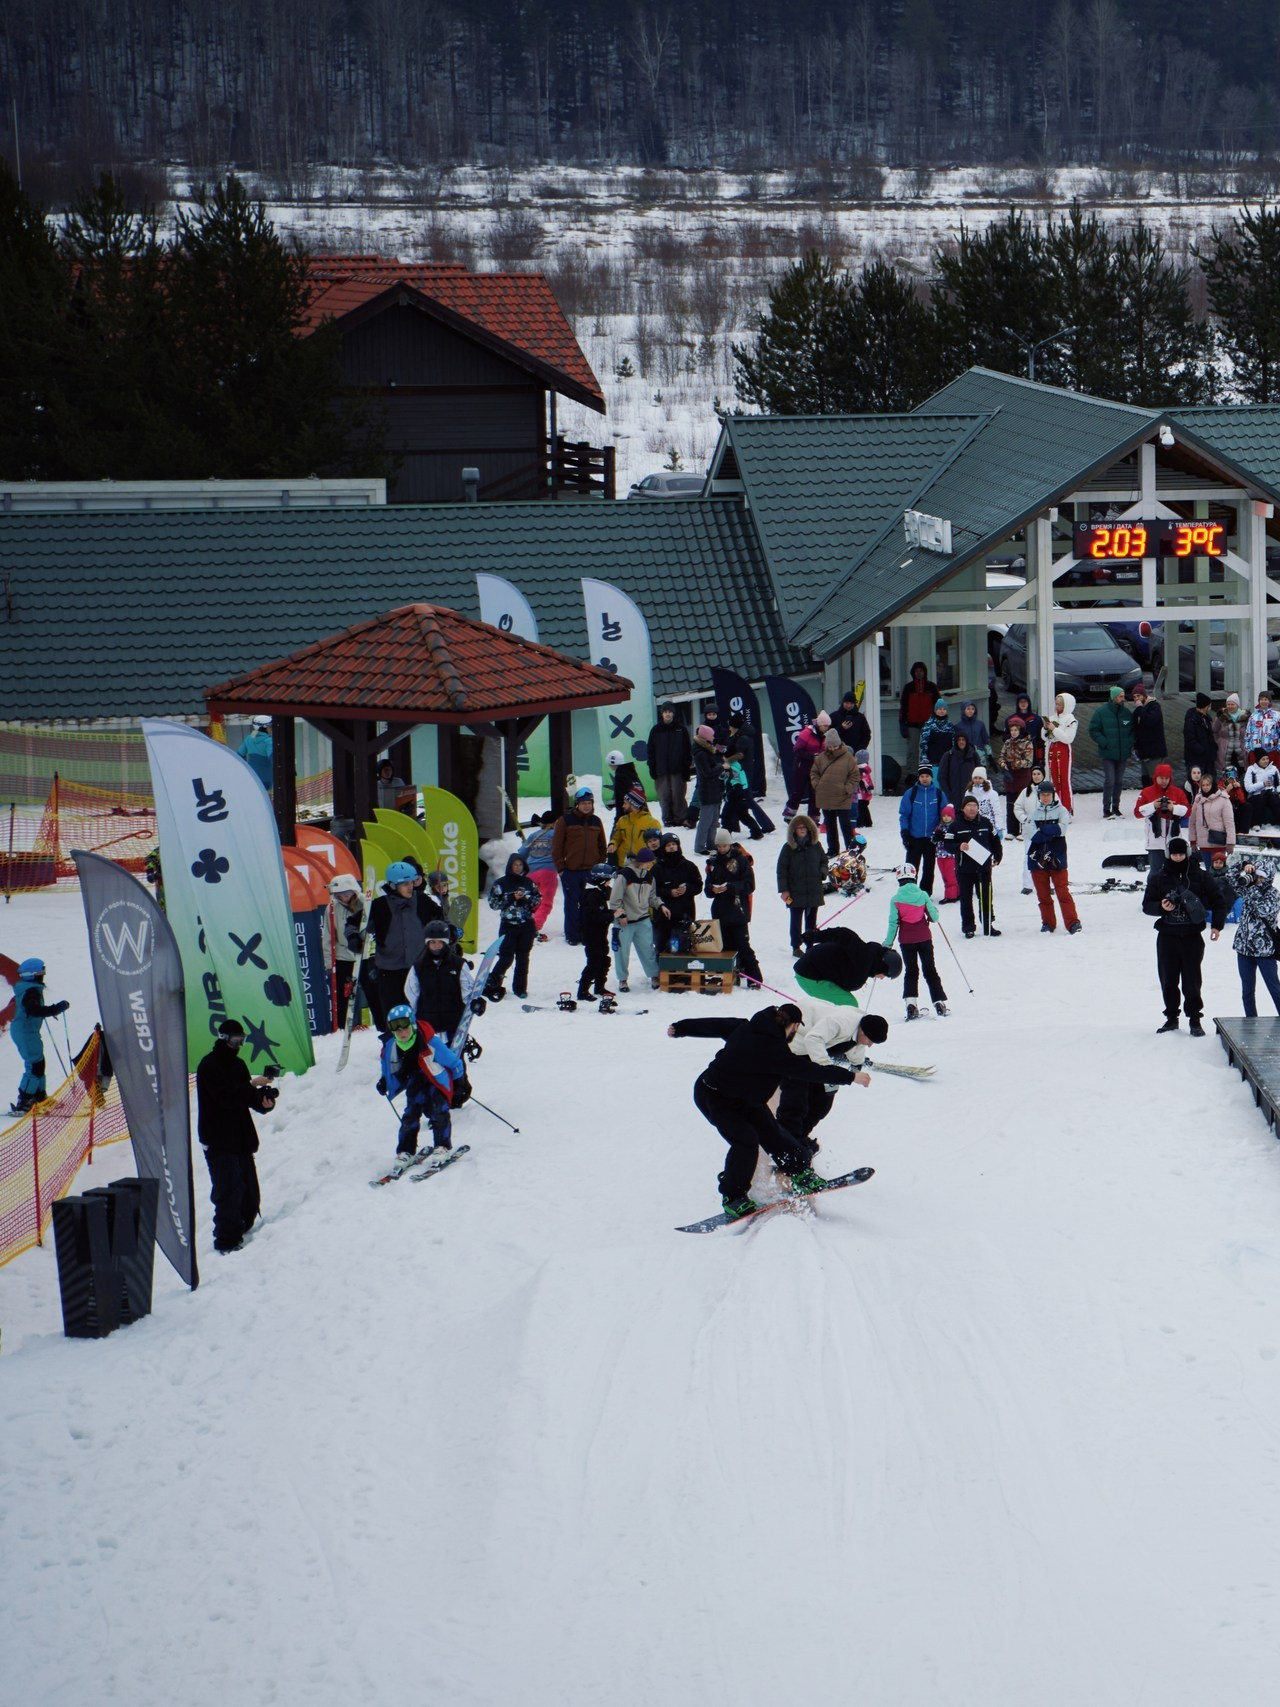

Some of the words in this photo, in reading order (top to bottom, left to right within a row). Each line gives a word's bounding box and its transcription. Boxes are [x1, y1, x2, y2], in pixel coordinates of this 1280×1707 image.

[1092, 529, 1147, 558] 2.03
[1116, 523, 1133, 531] ДАТА
[785, 701, 804, 745] oke
[439, 822, 459, 906] nvoke
